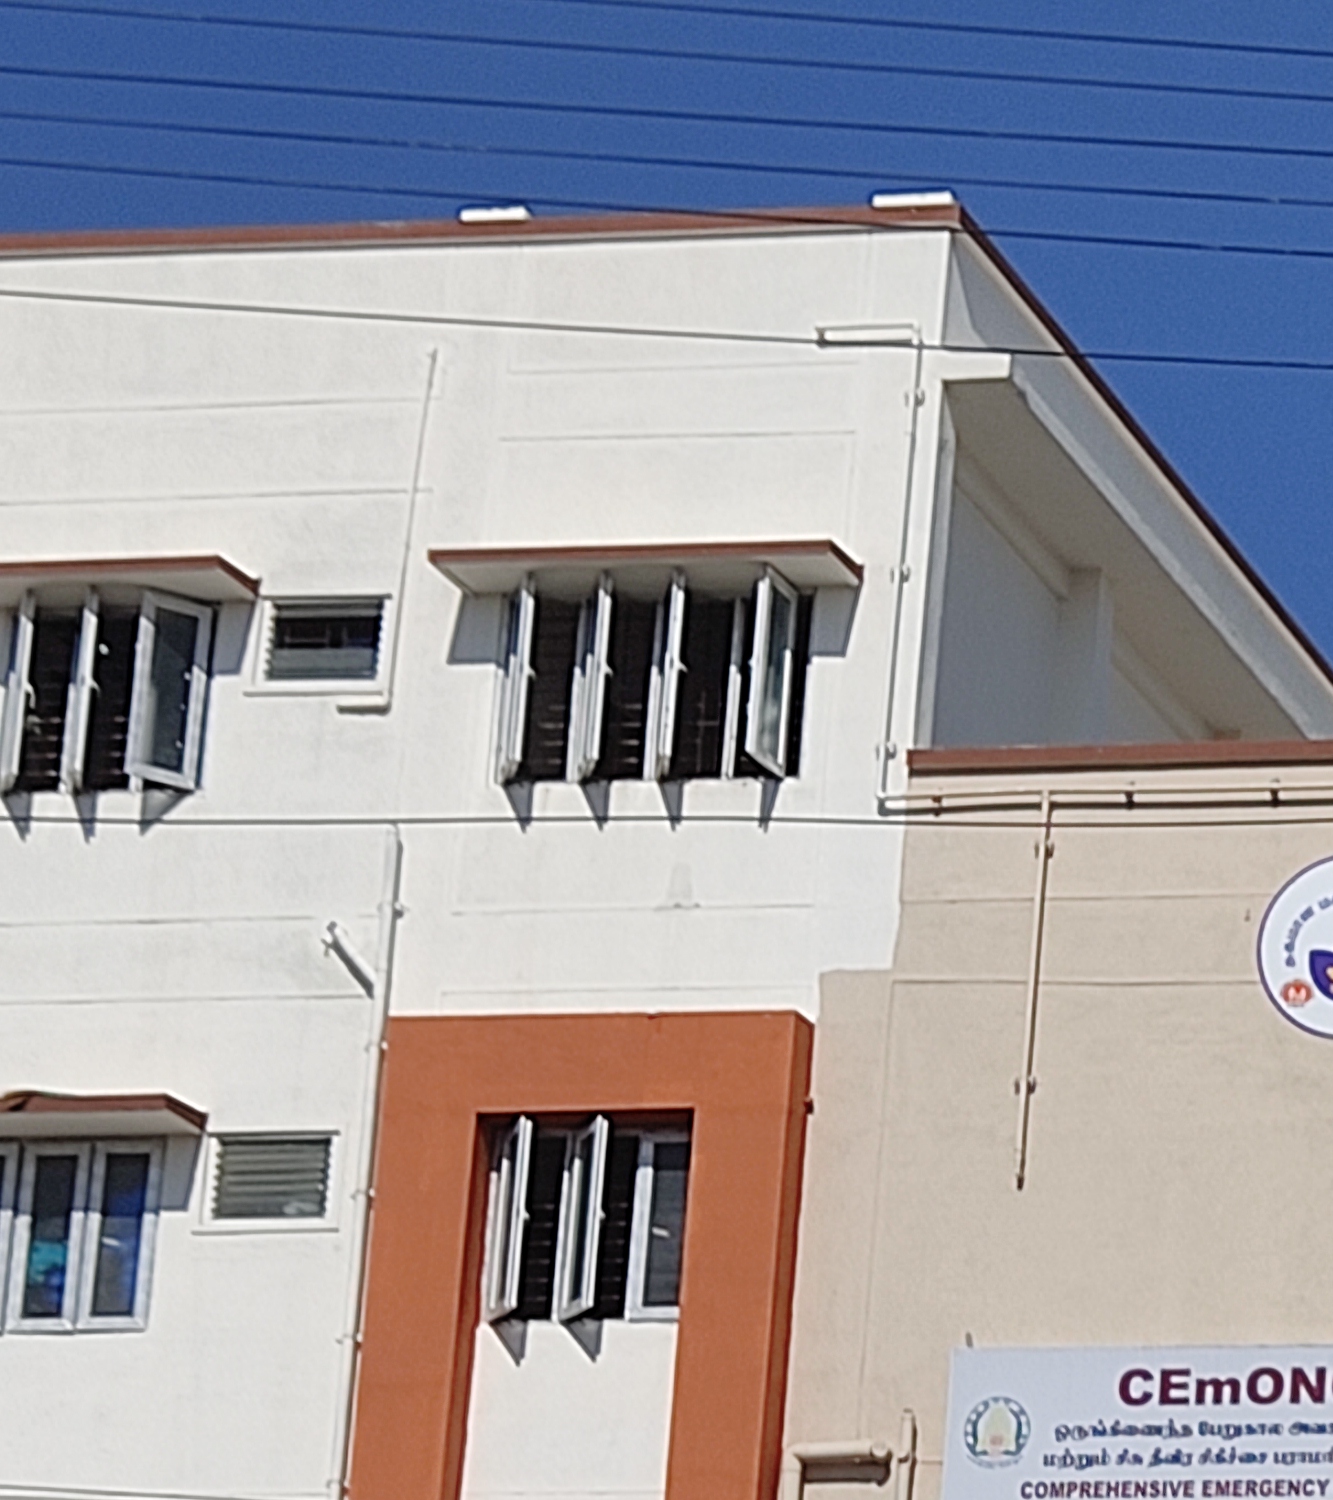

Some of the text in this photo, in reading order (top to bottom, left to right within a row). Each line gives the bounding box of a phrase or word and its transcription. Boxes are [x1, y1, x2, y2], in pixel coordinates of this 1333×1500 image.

[1043, 1447, 1110, 1470] மற்றும்
[1197, 1446, 1268, 1466] சிகிச்சை
[1020, 1480, 1195, 1500] COMPREHENSIVE
[1201, 1479, 1331, 1499] EMERGENCY
